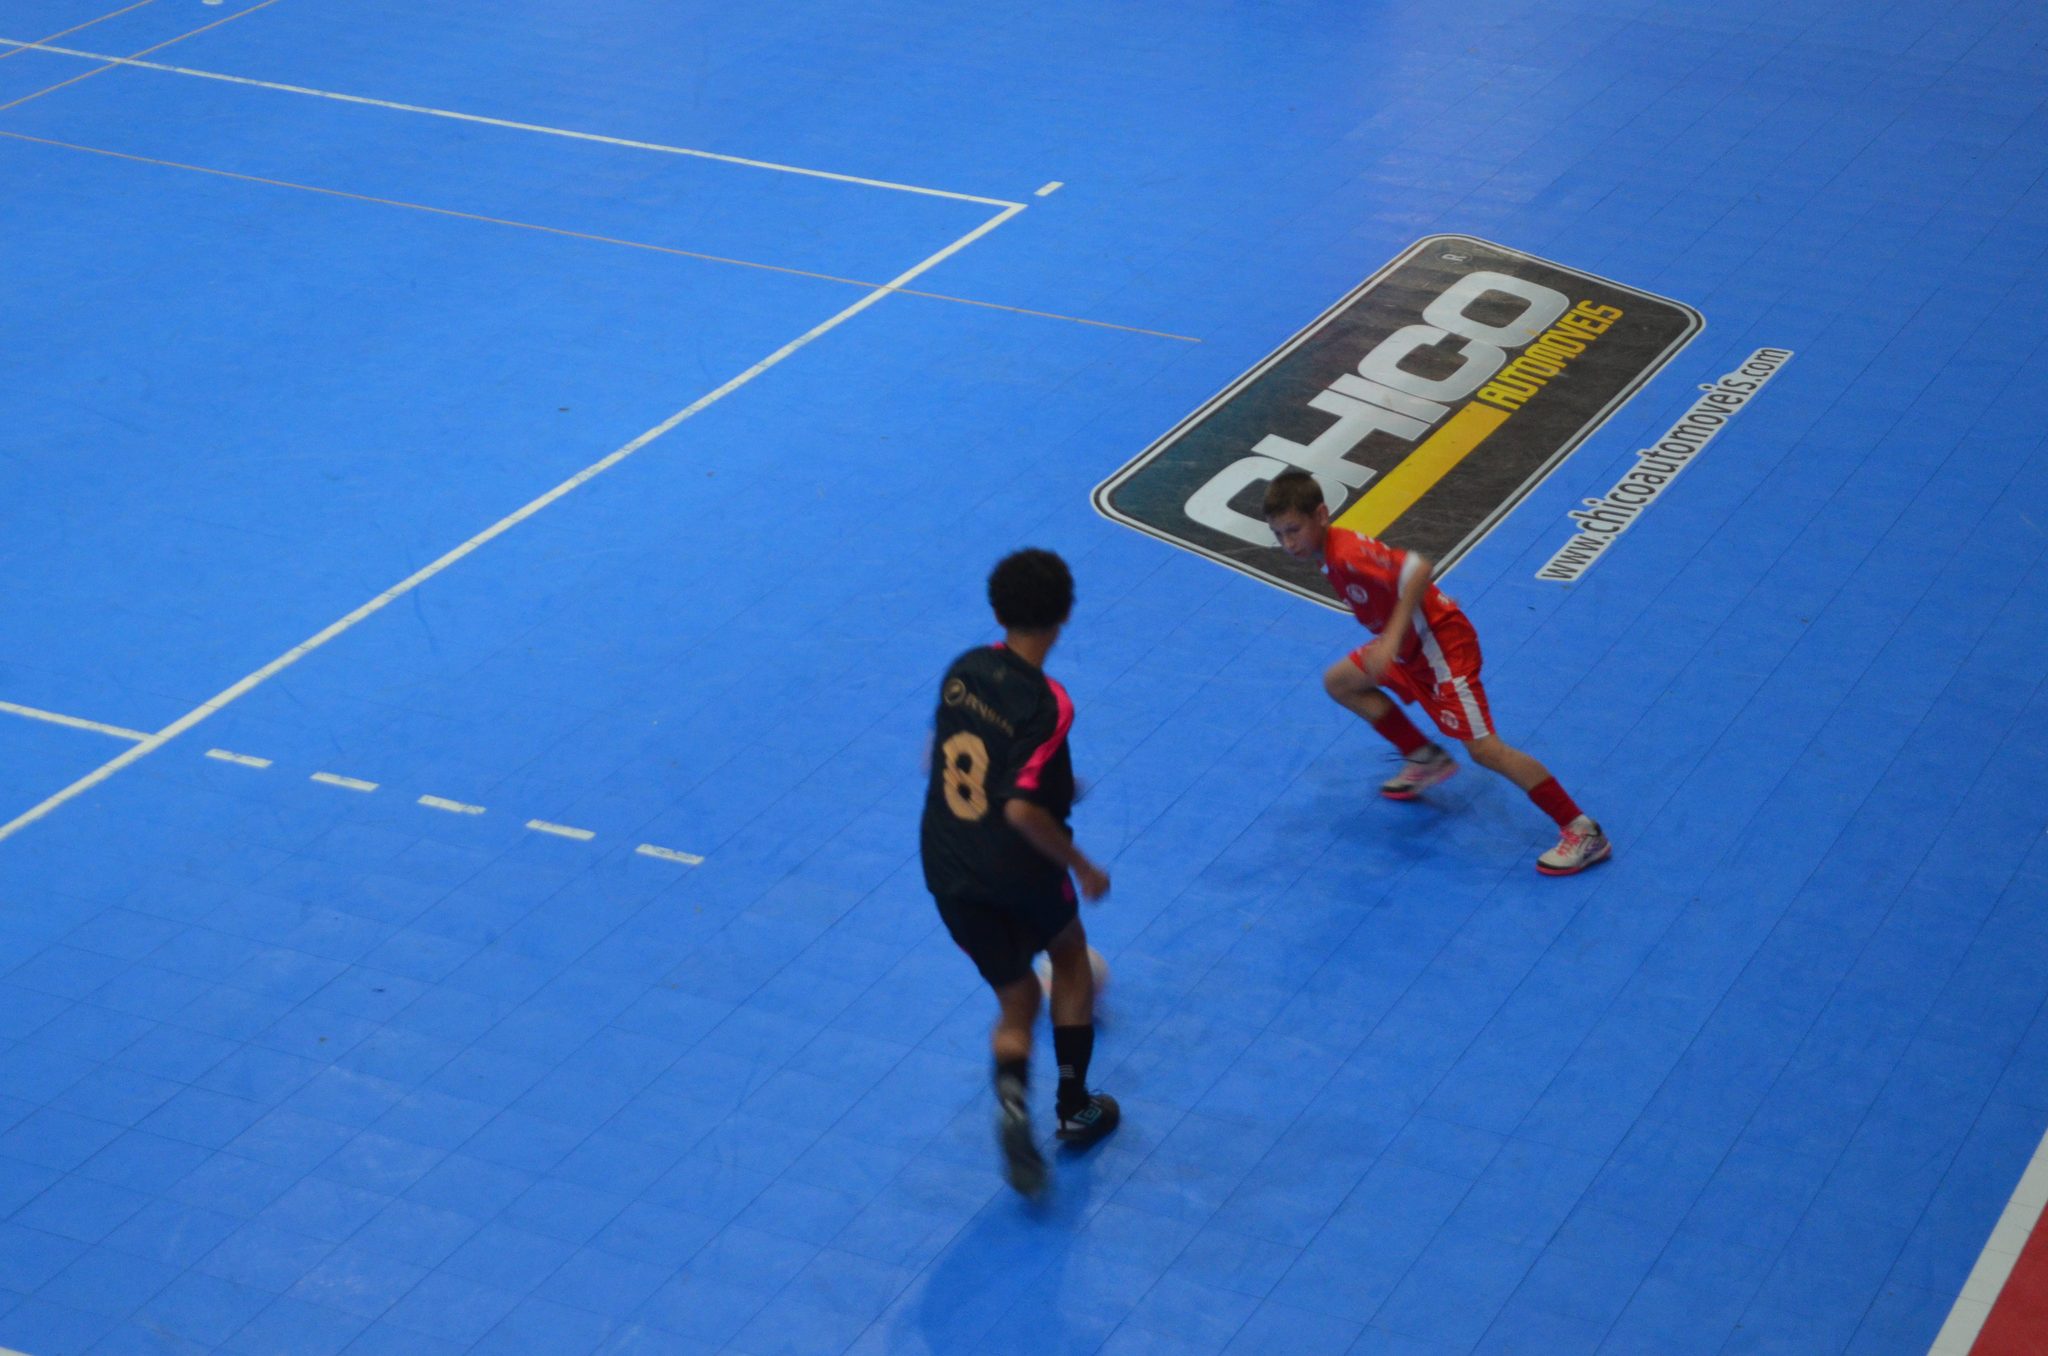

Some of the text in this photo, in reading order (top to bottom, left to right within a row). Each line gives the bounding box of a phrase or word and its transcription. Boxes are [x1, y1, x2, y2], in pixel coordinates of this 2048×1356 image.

[1184, 271, 1571, 547] CHICO
[1541, 348, 1789, 581] www.chicoautomoveis.com
[942, 731, 990, 820] 8
